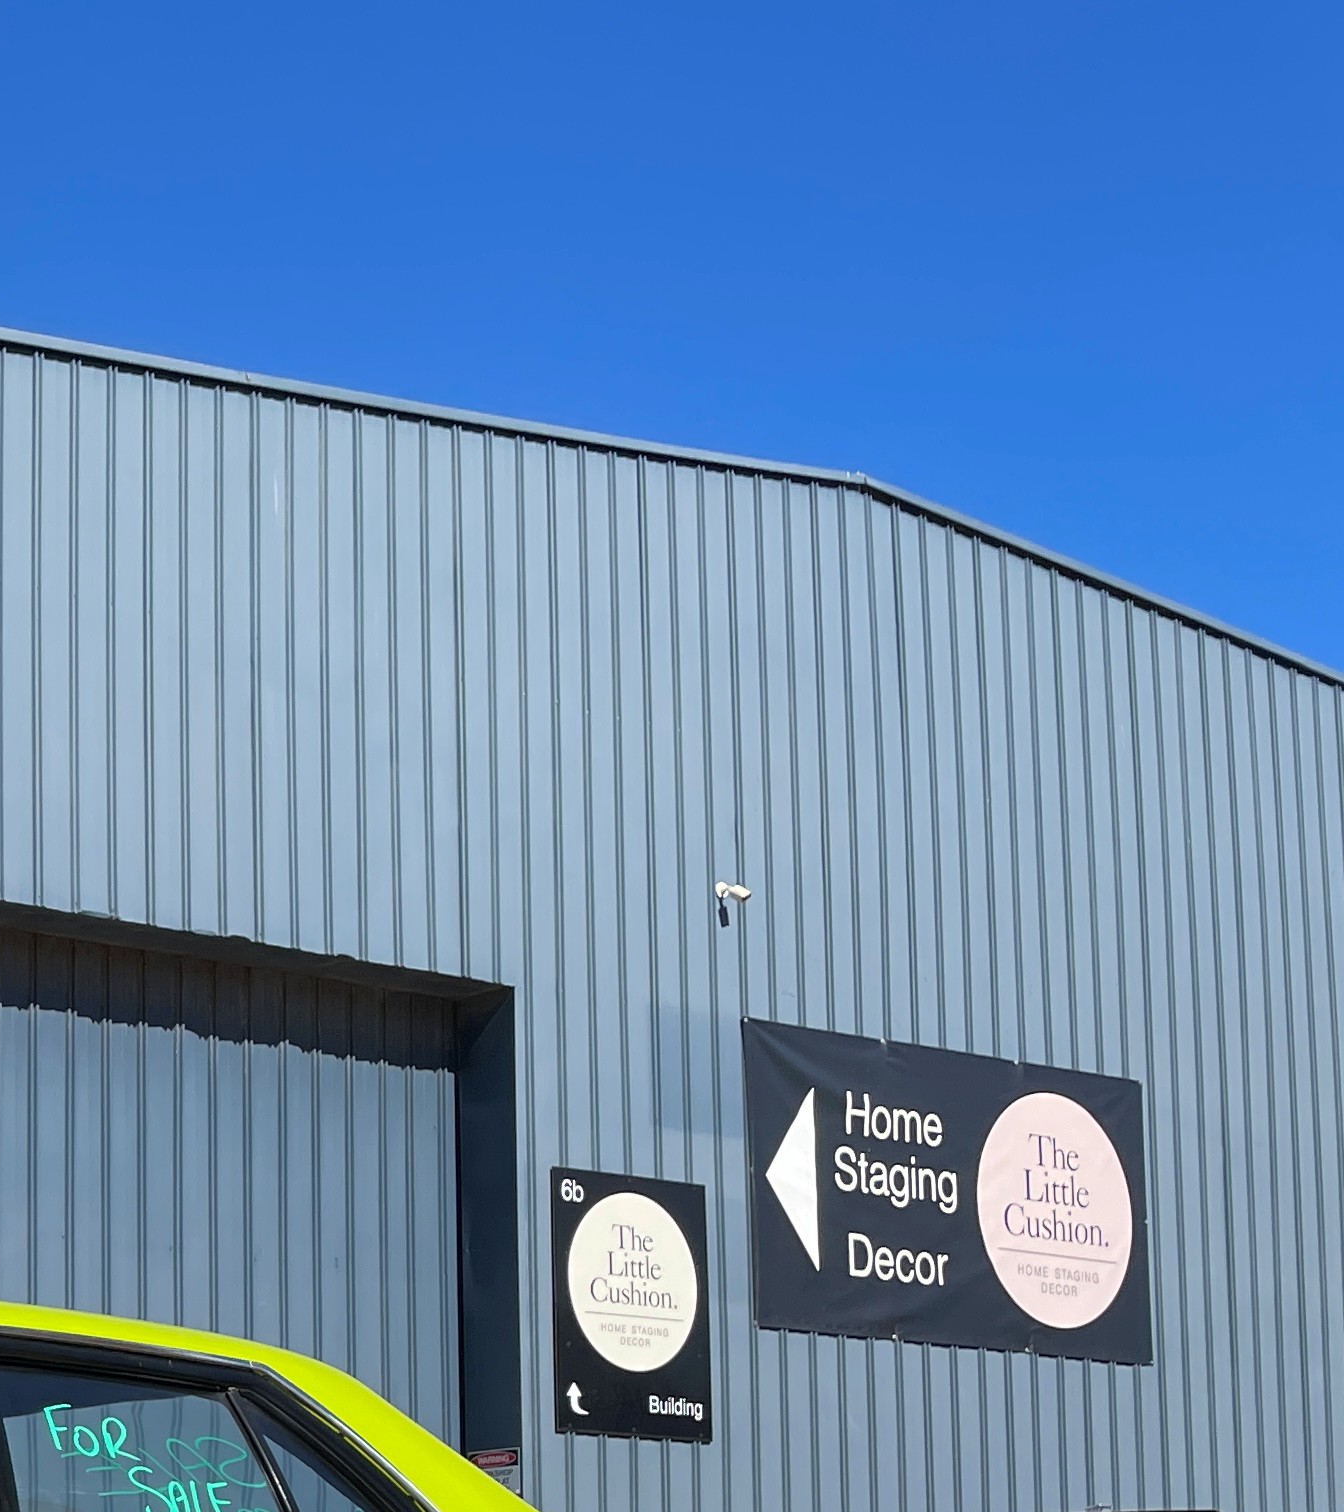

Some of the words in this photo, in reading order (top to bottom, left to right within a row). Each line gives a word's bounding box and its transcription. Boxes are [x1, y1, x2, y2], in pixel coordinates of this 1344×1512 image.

[845, 1090, 943, 1147] Home
[1028, 1133, 1080, 1172] The
[561, 1179, 584, 1203] 6b
[834, 1145, 958, 1214] Staging
[1023, 1169, 1090, 1208] Little
[612, 1223, 654, 1252] The
[1003, 1203, 1110, 1248] Cushion.
[608, 1250, 662, 1280] Little
[848, 1232, 949, 1287] Decor
[1017, 1264, 1049, 1279] HOME
[1054, 1267, 1100, 1285] STAGING
[590, 1276, 679, 1310] Cushion.
[1041, 1281, 1078, 1297] DECOR
[600, 1322, 627, 1334] HOME
[631, 1324, 670, 1338] STAGING
[620, 1336, 651, 1348] DECOR
[649, 1395, 704, 1422] Building
[44, 1403, 142, 1461] FOR
